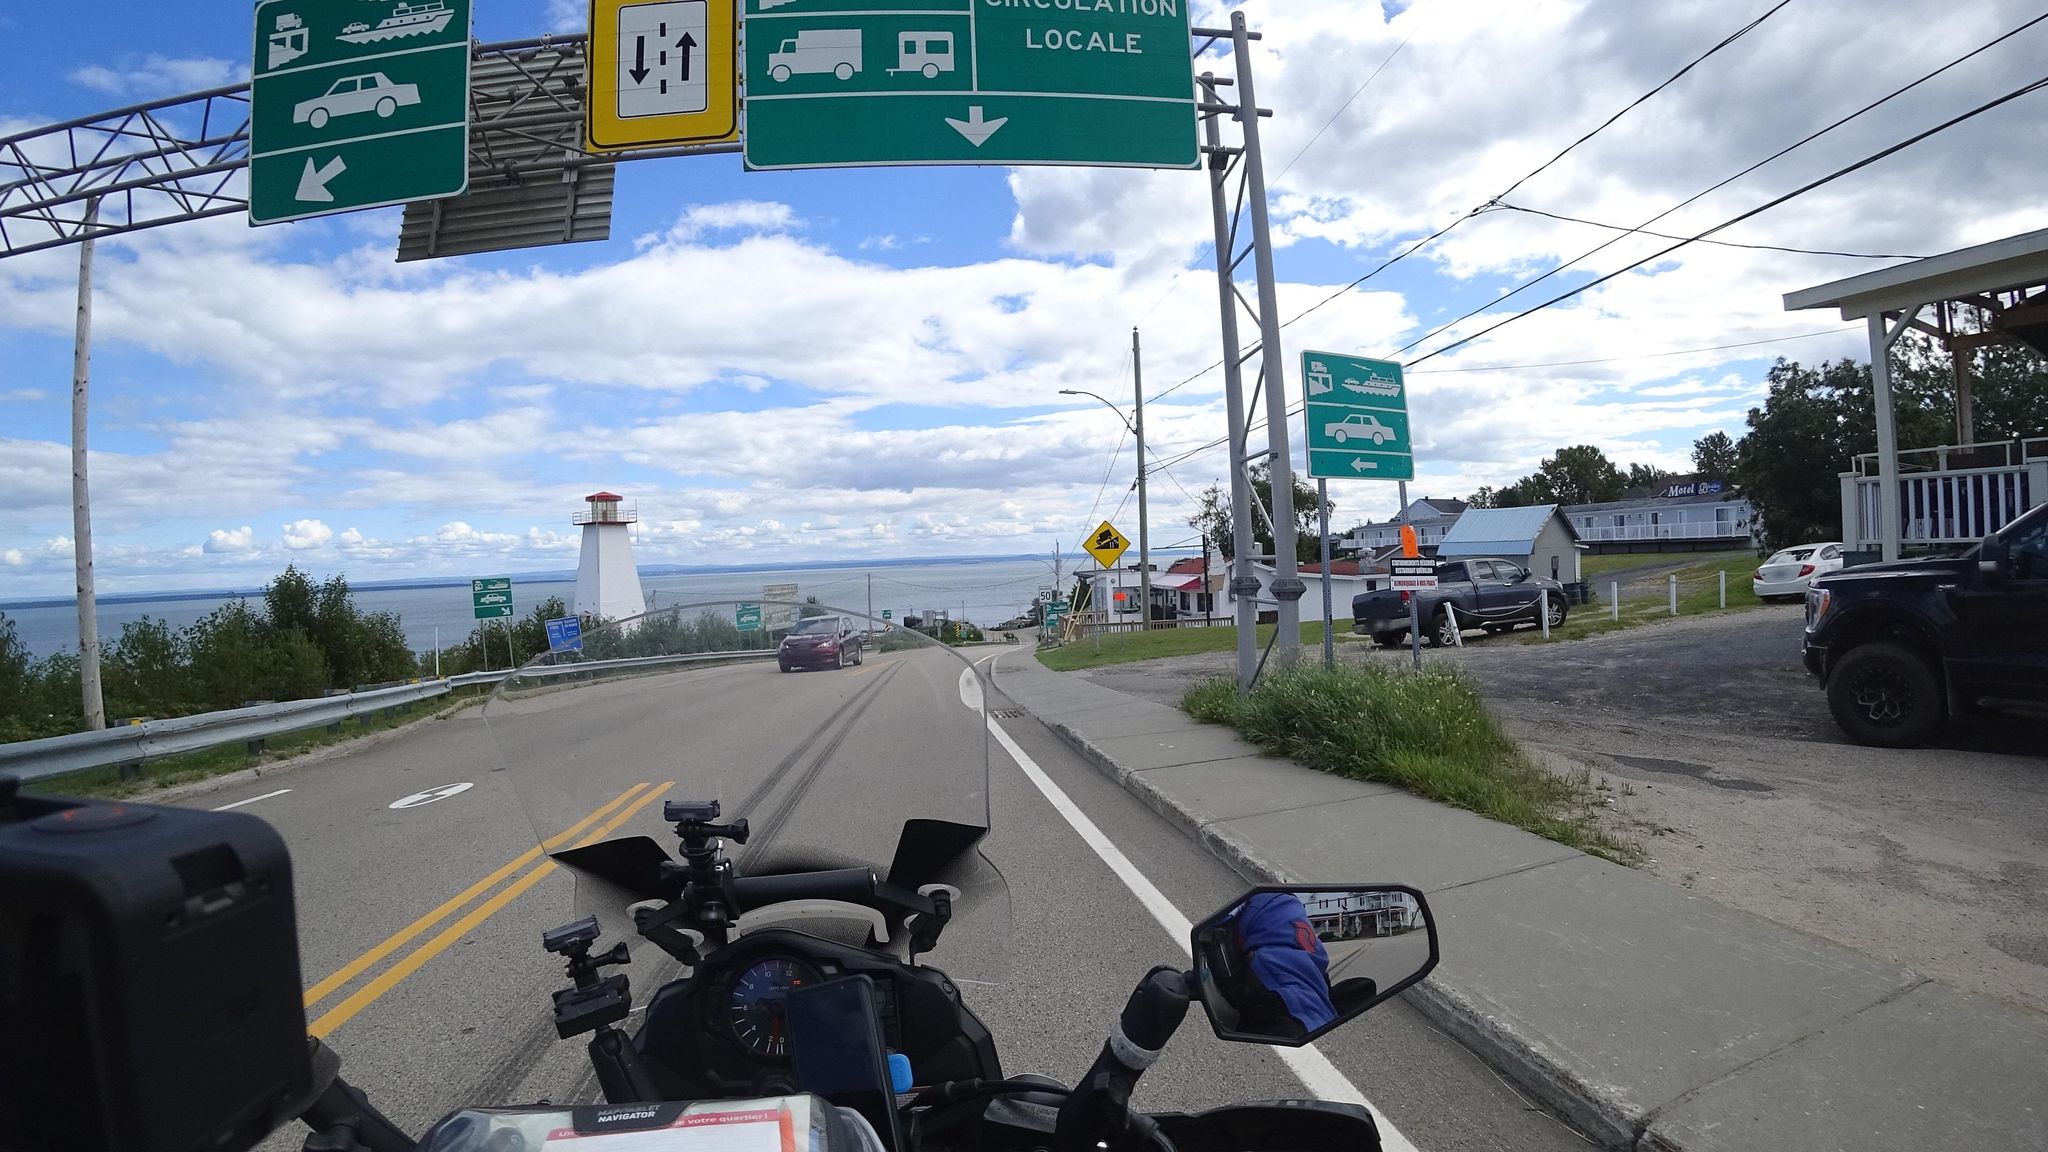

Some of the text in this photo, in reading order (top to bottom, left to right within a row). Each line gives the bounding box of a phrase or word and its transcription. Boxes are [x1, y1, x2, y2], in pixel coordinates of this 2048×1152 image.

[1026, 28, 1142, 54] LOCALE
[1668, 483, 1695, 497] Motel
[1040, 591, 1051, 601] 50
[598, 1111, 656, 1123] NAVIGATOR
[688, 1117, 717, 1125] votre
